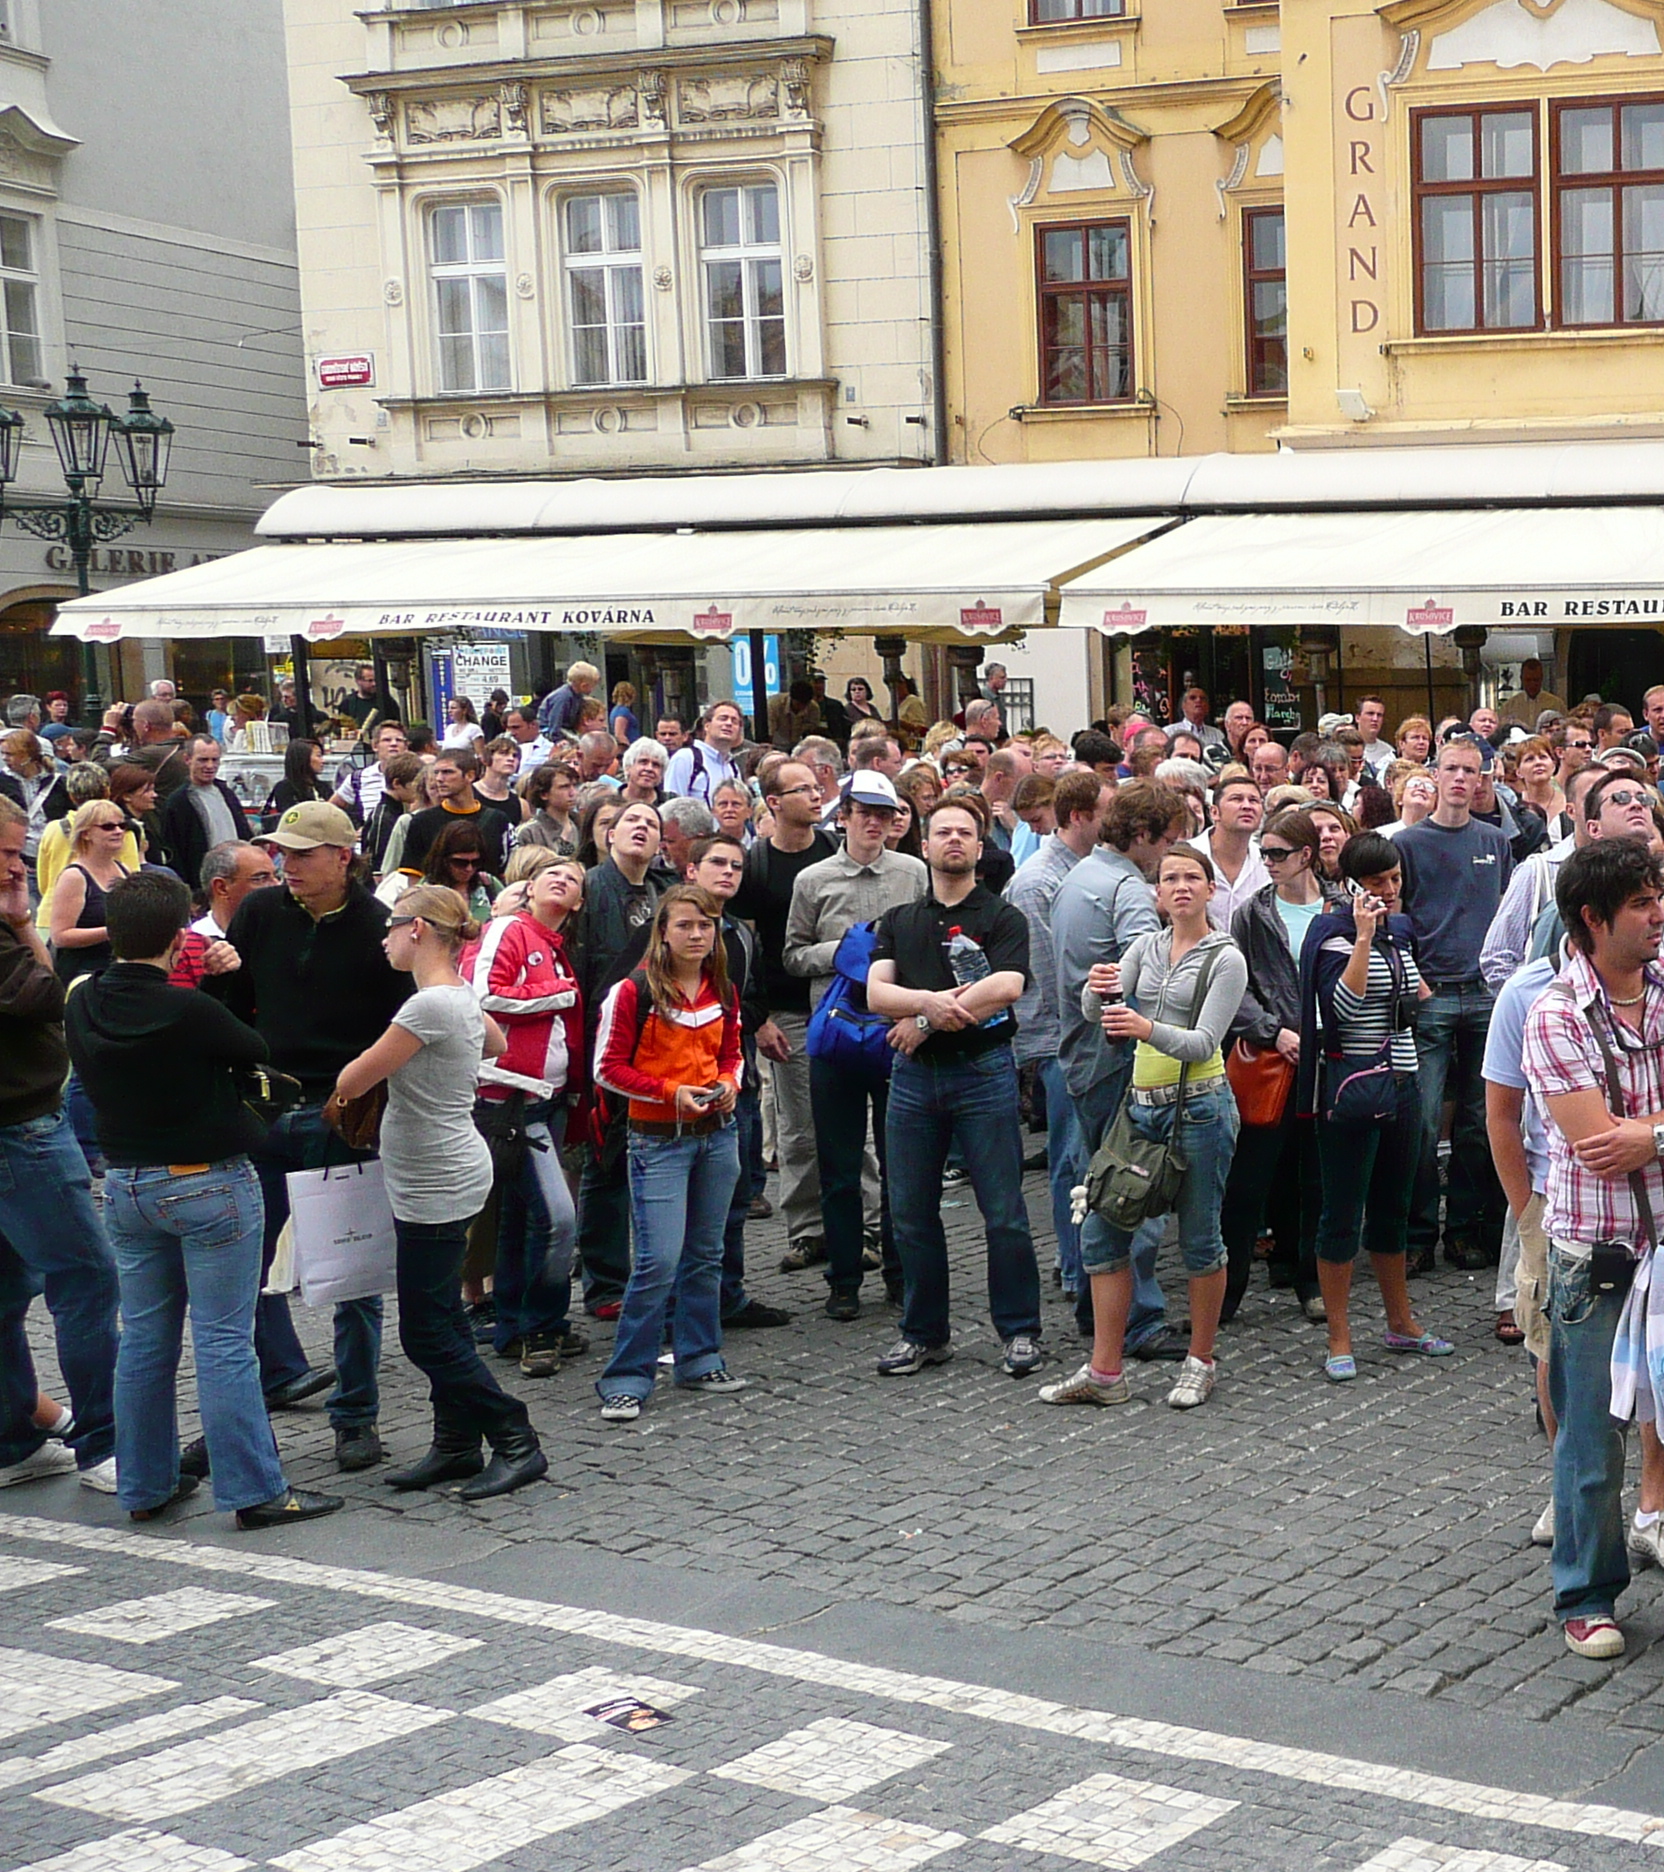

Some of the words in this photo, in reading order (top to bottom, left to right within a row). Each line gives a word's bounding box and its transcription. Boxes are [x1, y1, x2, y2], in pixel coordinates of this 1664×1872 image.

[1345, 86, 1379, 334] GRAND
[379, 614, 414, 625] BAR
[425, 611, 551, 625] RESTAURANT
[561, 608, 655, 625] KOVÁRNA
[1500, 600, 1548, 617] BAR
[455, 656, 507, 667] CHANGE
